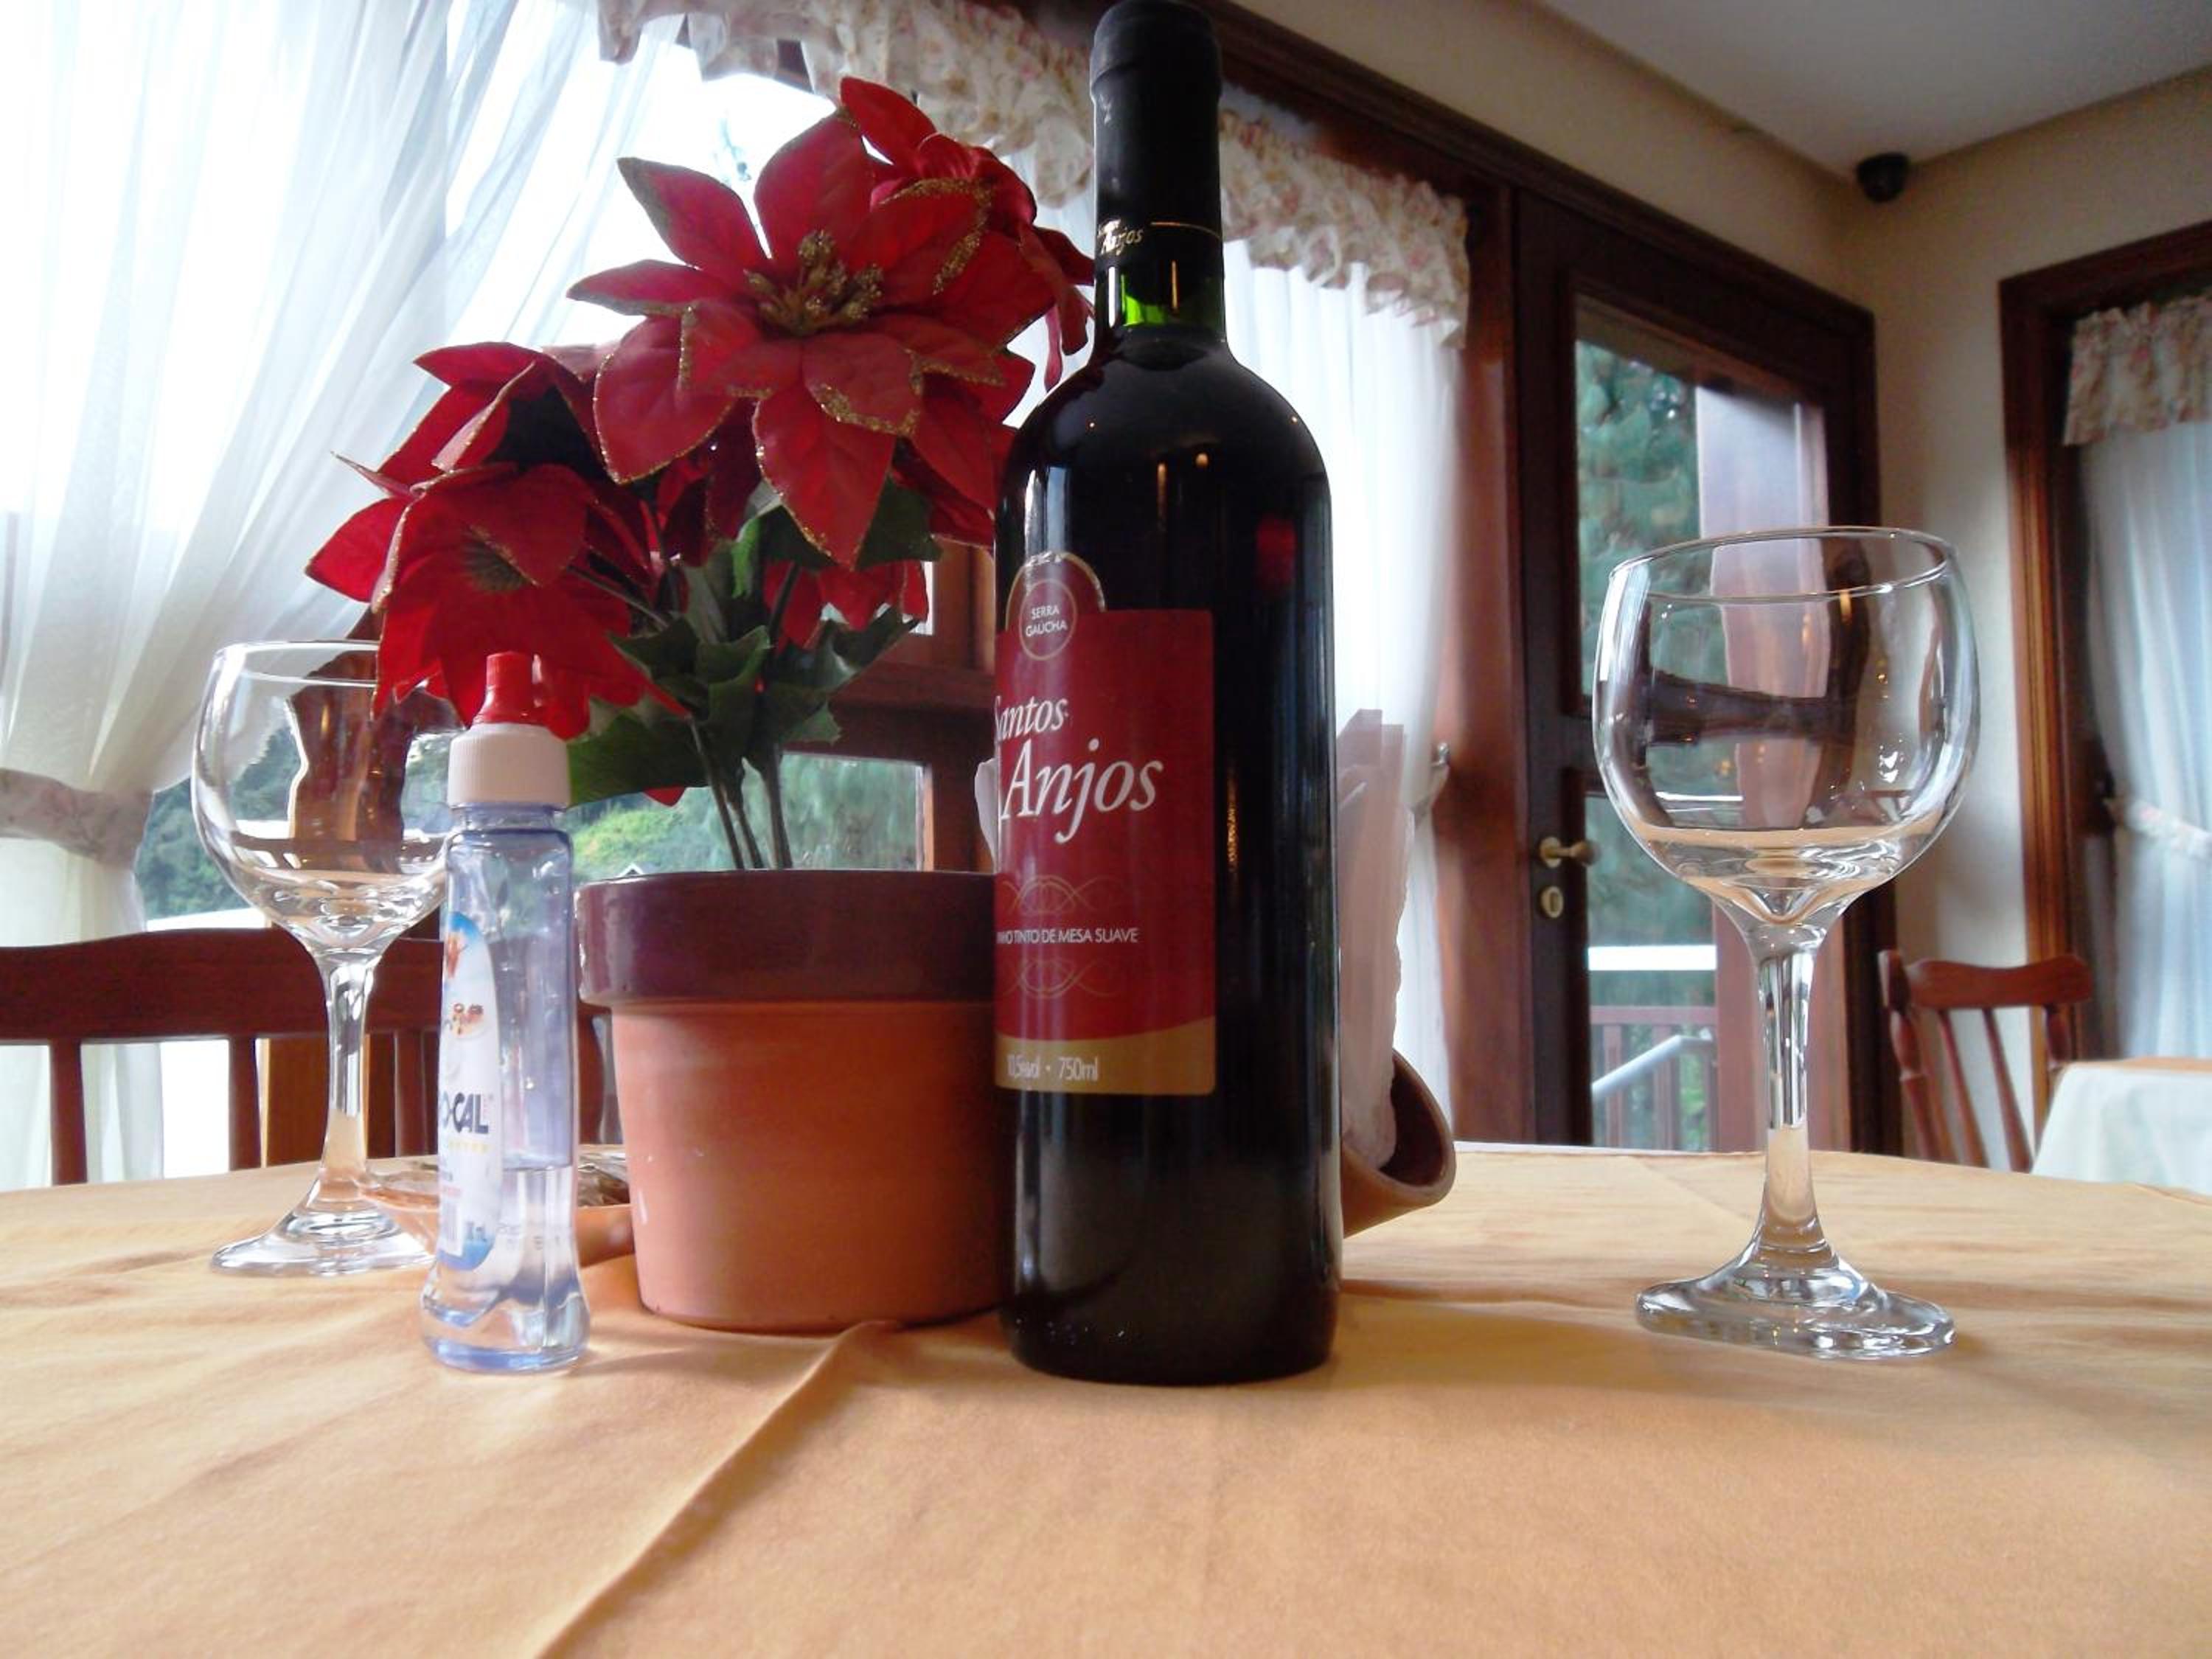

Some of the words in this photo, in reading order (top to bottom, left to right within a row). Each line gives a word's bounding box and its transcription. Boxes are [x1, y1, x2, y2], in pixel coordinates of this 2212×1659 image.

[1031, 605, 1060, 621] SERRA
[1000, 737, 1164, 844] Anjos
[1014, 929, 1040, 944] TINTO
[1041, 928, 1056, 943] DE
[1058, 928, 1093, 943] MESA
[1095, 927, 1139, 943] SUAVE
